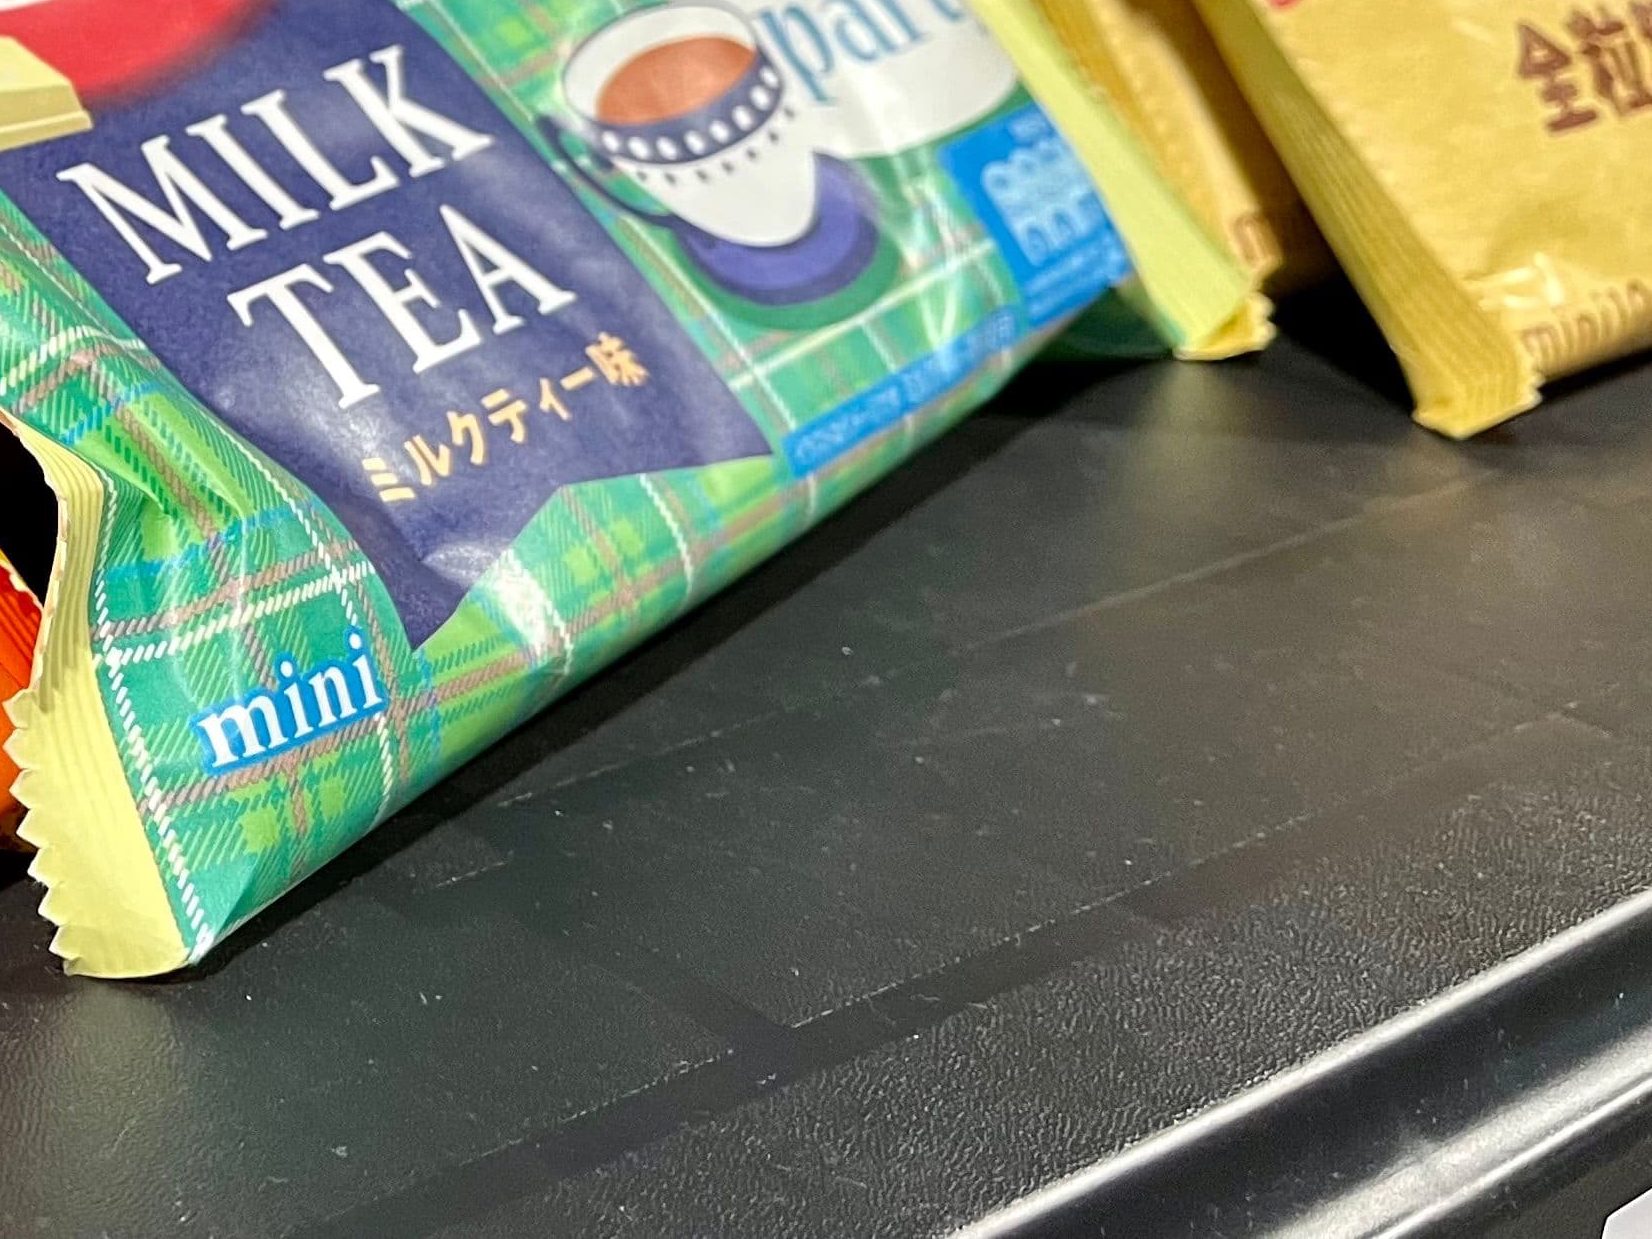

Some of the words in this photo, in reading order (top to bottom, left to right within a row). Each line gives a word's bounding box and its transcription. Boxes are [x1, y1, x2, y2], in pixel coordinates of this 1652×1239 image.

[57, 45, 495, 284] MILK
[227, 205, 577, 409] TEA
[361, 333, 650, 504] ミルクティー味
[198, 633, 383, 768] mini
